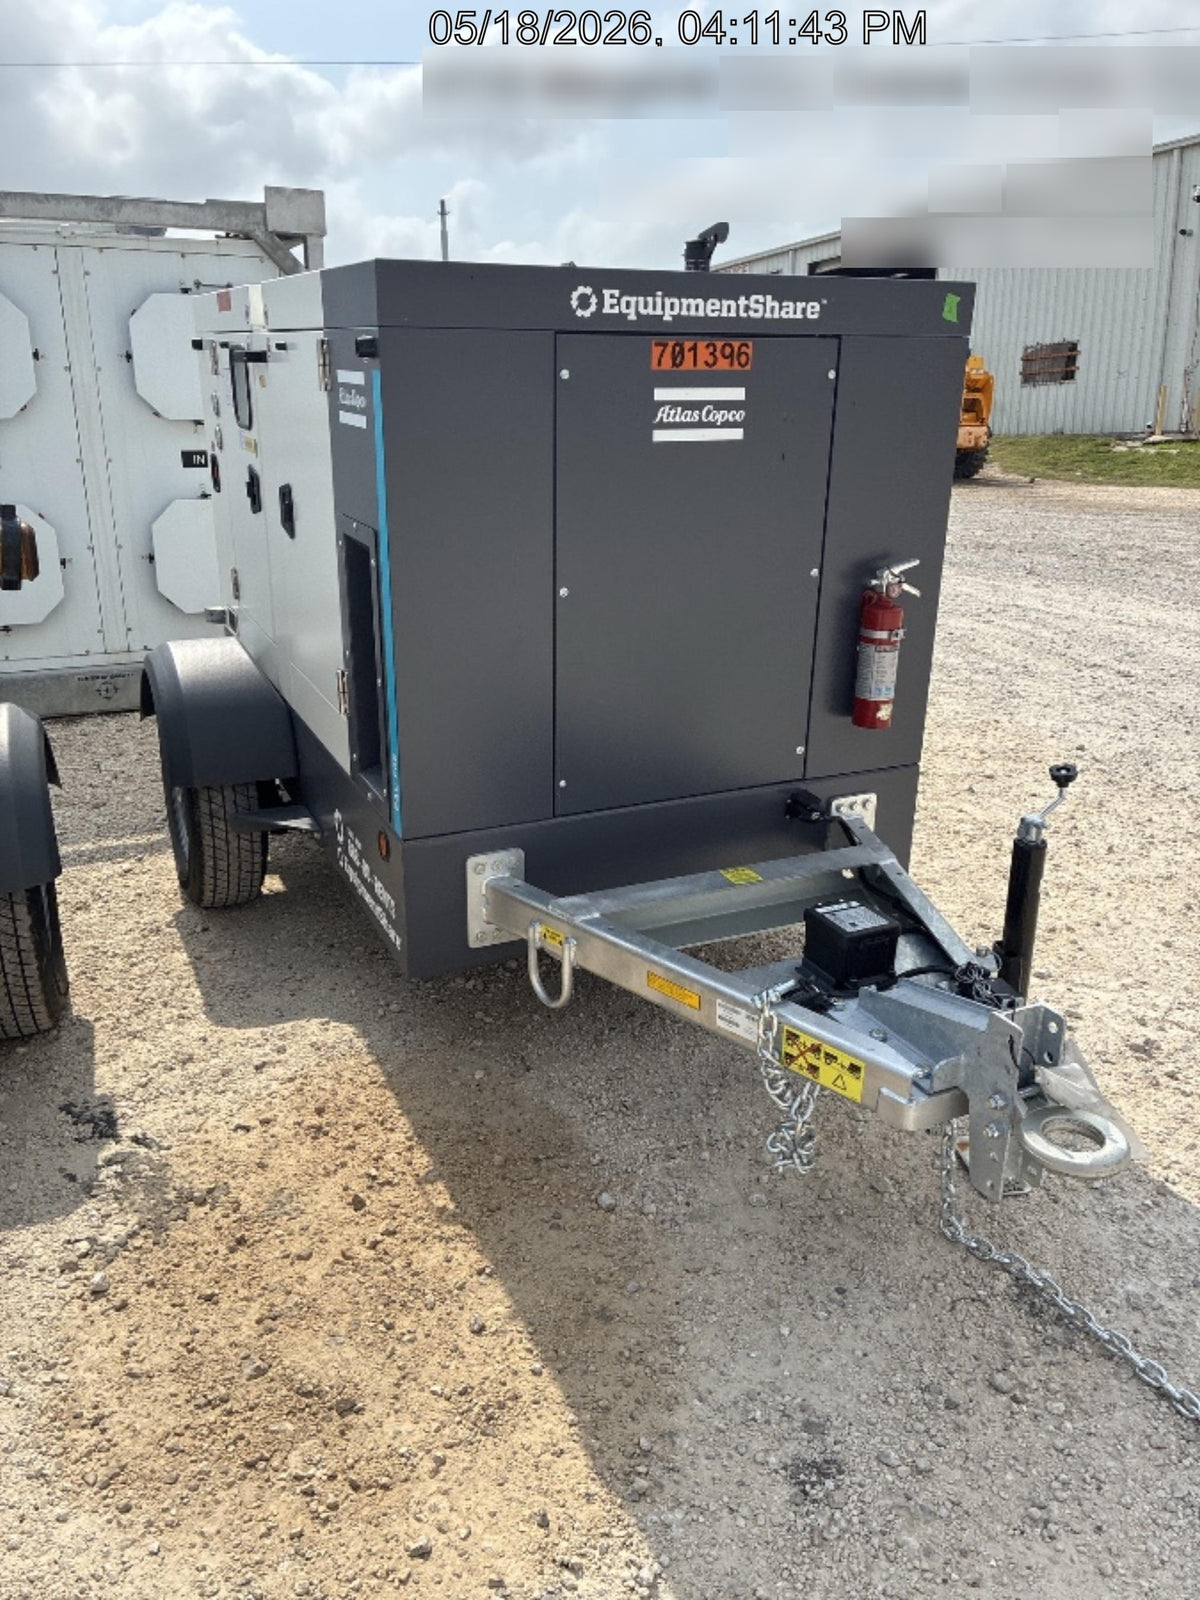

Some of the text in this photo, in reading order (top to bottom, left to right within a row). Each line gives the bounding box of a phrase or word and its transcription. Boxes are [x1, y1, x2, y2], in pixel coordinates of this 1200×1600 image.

[601, 288, 821, 321] EquipmentShare
[653, 341, 751, 369] 701396
[652, 404, 745, 425] Atlas Copco
[192, 454, 205, 465] IN
